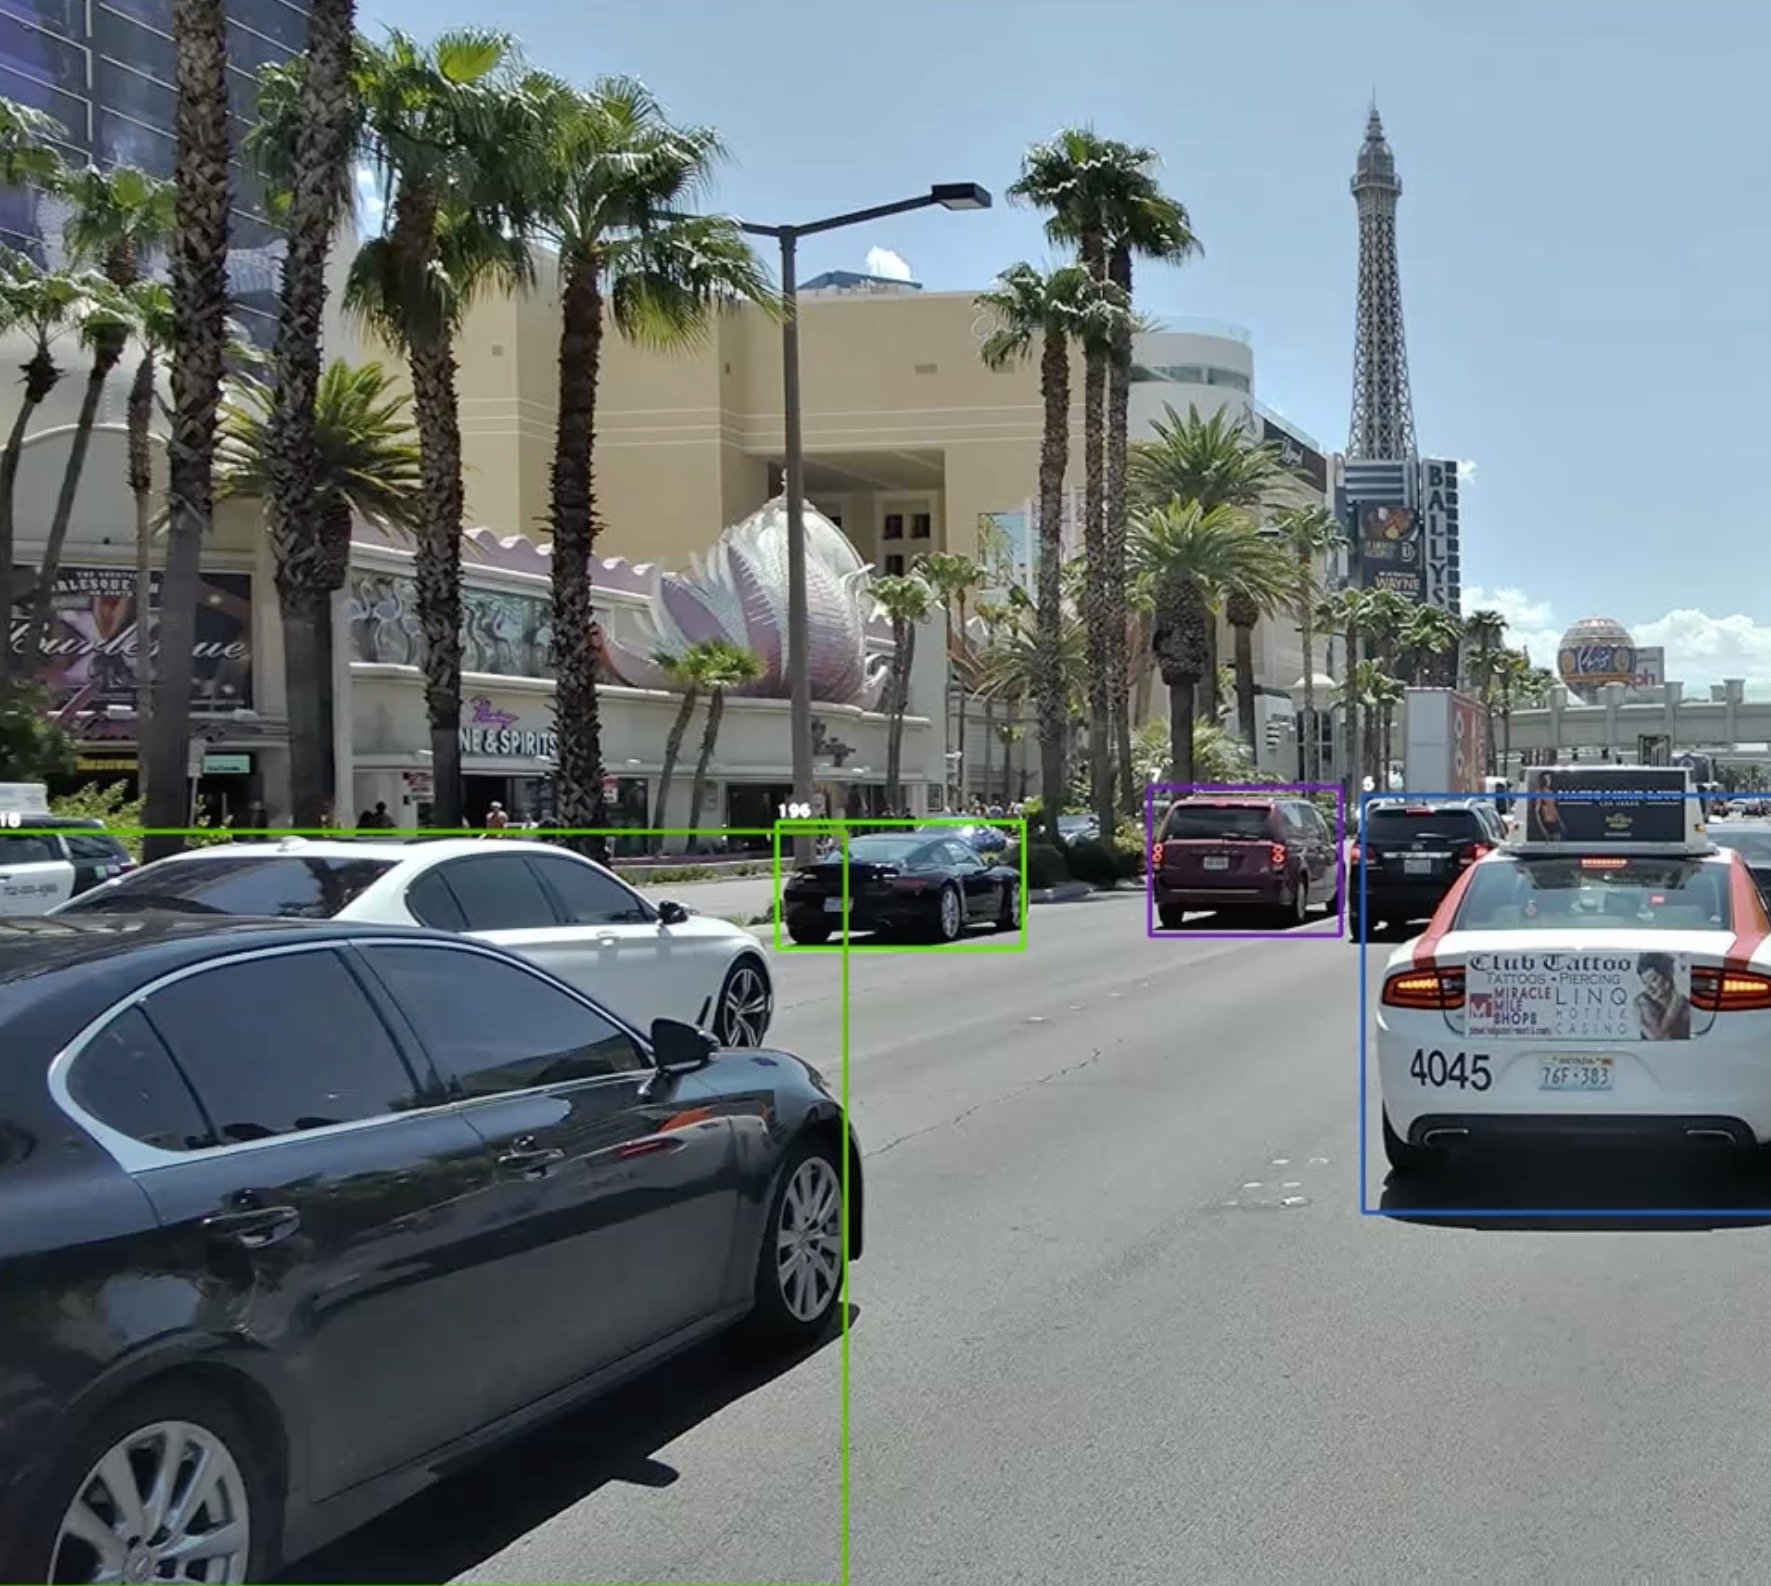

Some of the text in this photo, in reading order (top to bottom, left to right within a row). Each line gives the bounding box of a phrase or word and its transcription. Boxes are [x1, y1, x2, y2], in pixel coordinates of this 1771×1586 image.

[51, 578, 130, 592] RLESQUE
[1469, 953, 1632, 972] Club Tattoo
[1494, 986, 1628, 1007] MIRACLE LINQ
[1494, 1000, 1522, 1012] MILE
[1493, 1012, 1538, 1025] SHOPS
[1555, 1008, 1614, 1019] HOTEL
[1555, 1023, 1628, 1035] CASINO
[1410, 1048, 1492, 1092] 4045
